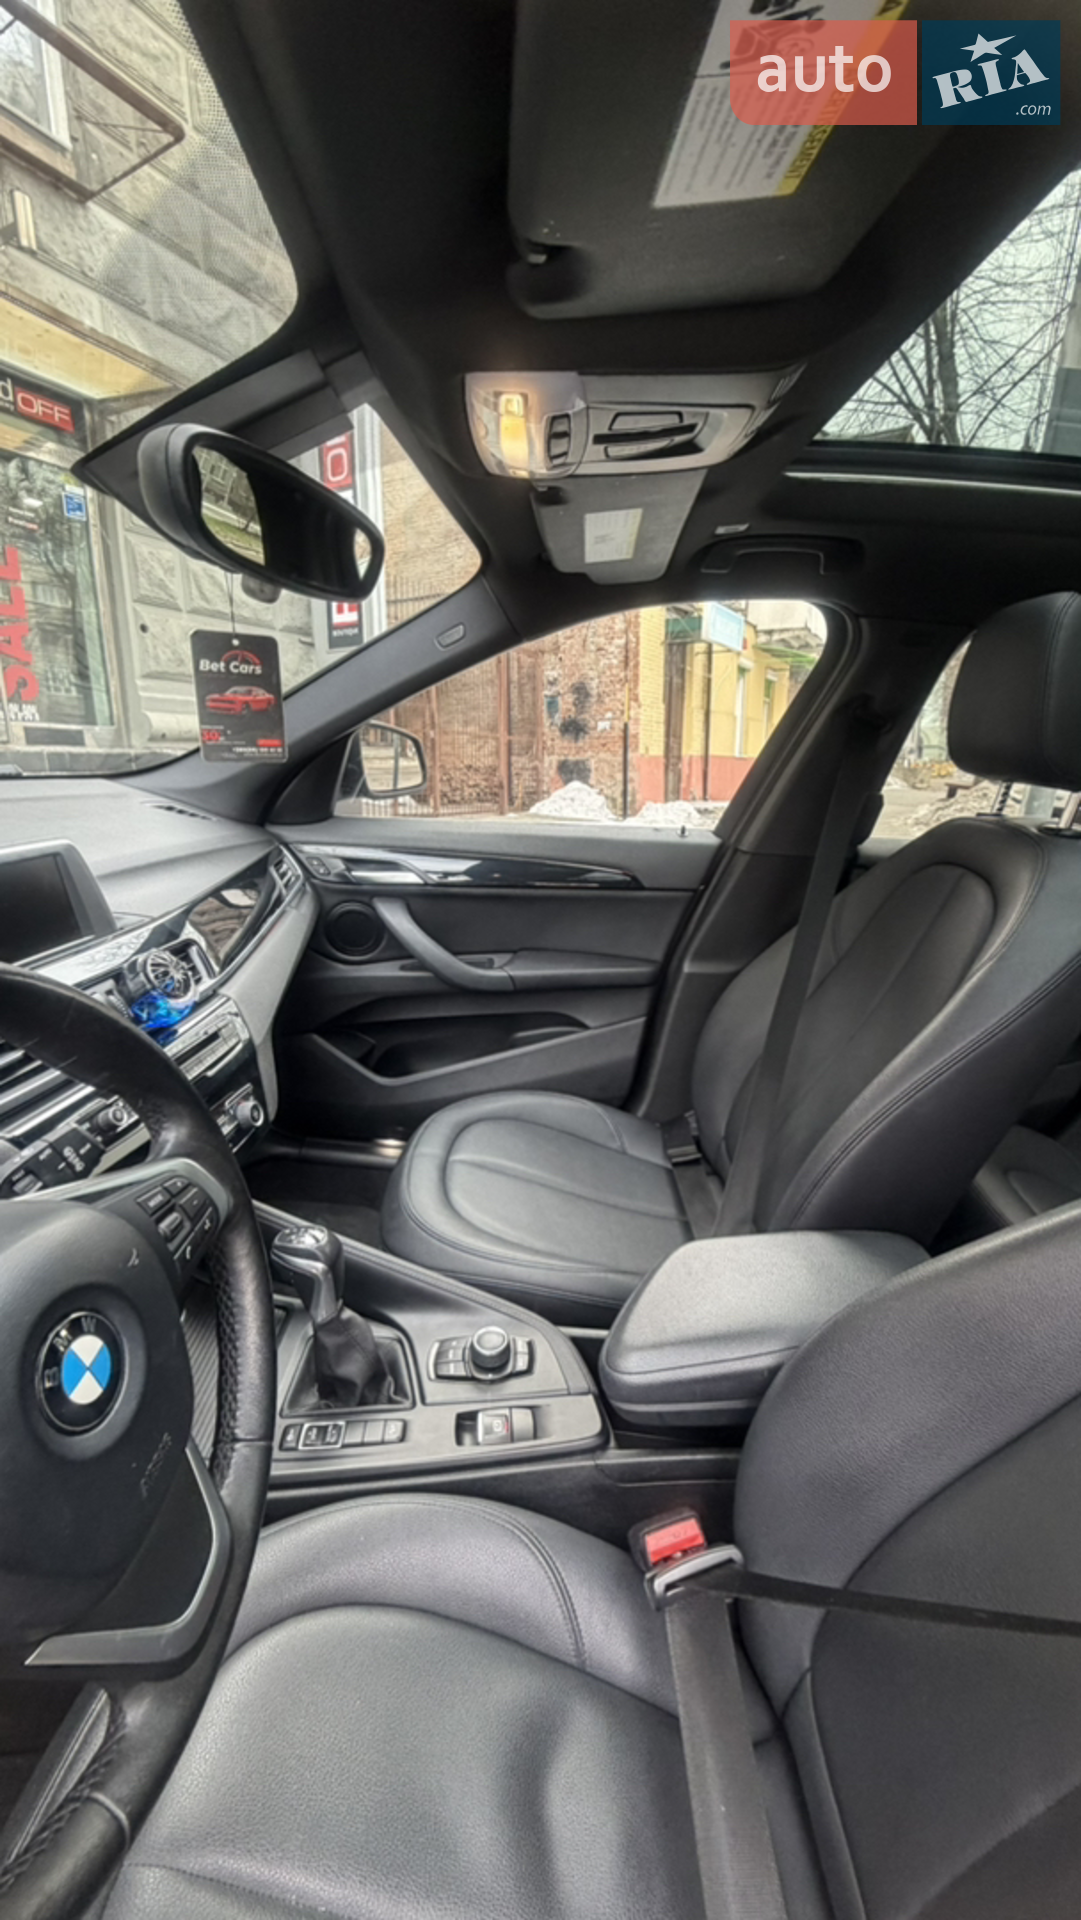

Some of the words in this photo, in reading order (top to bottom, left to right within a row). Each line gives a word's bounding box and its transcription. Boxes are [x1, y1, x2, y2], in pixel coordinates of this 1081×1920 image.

[18, 393, 70, 422] OFF
[199, 659, 227, 673] Bet
[229, 660, 263, 675] Cars
[43, 1316, 97, 1389] BMW
